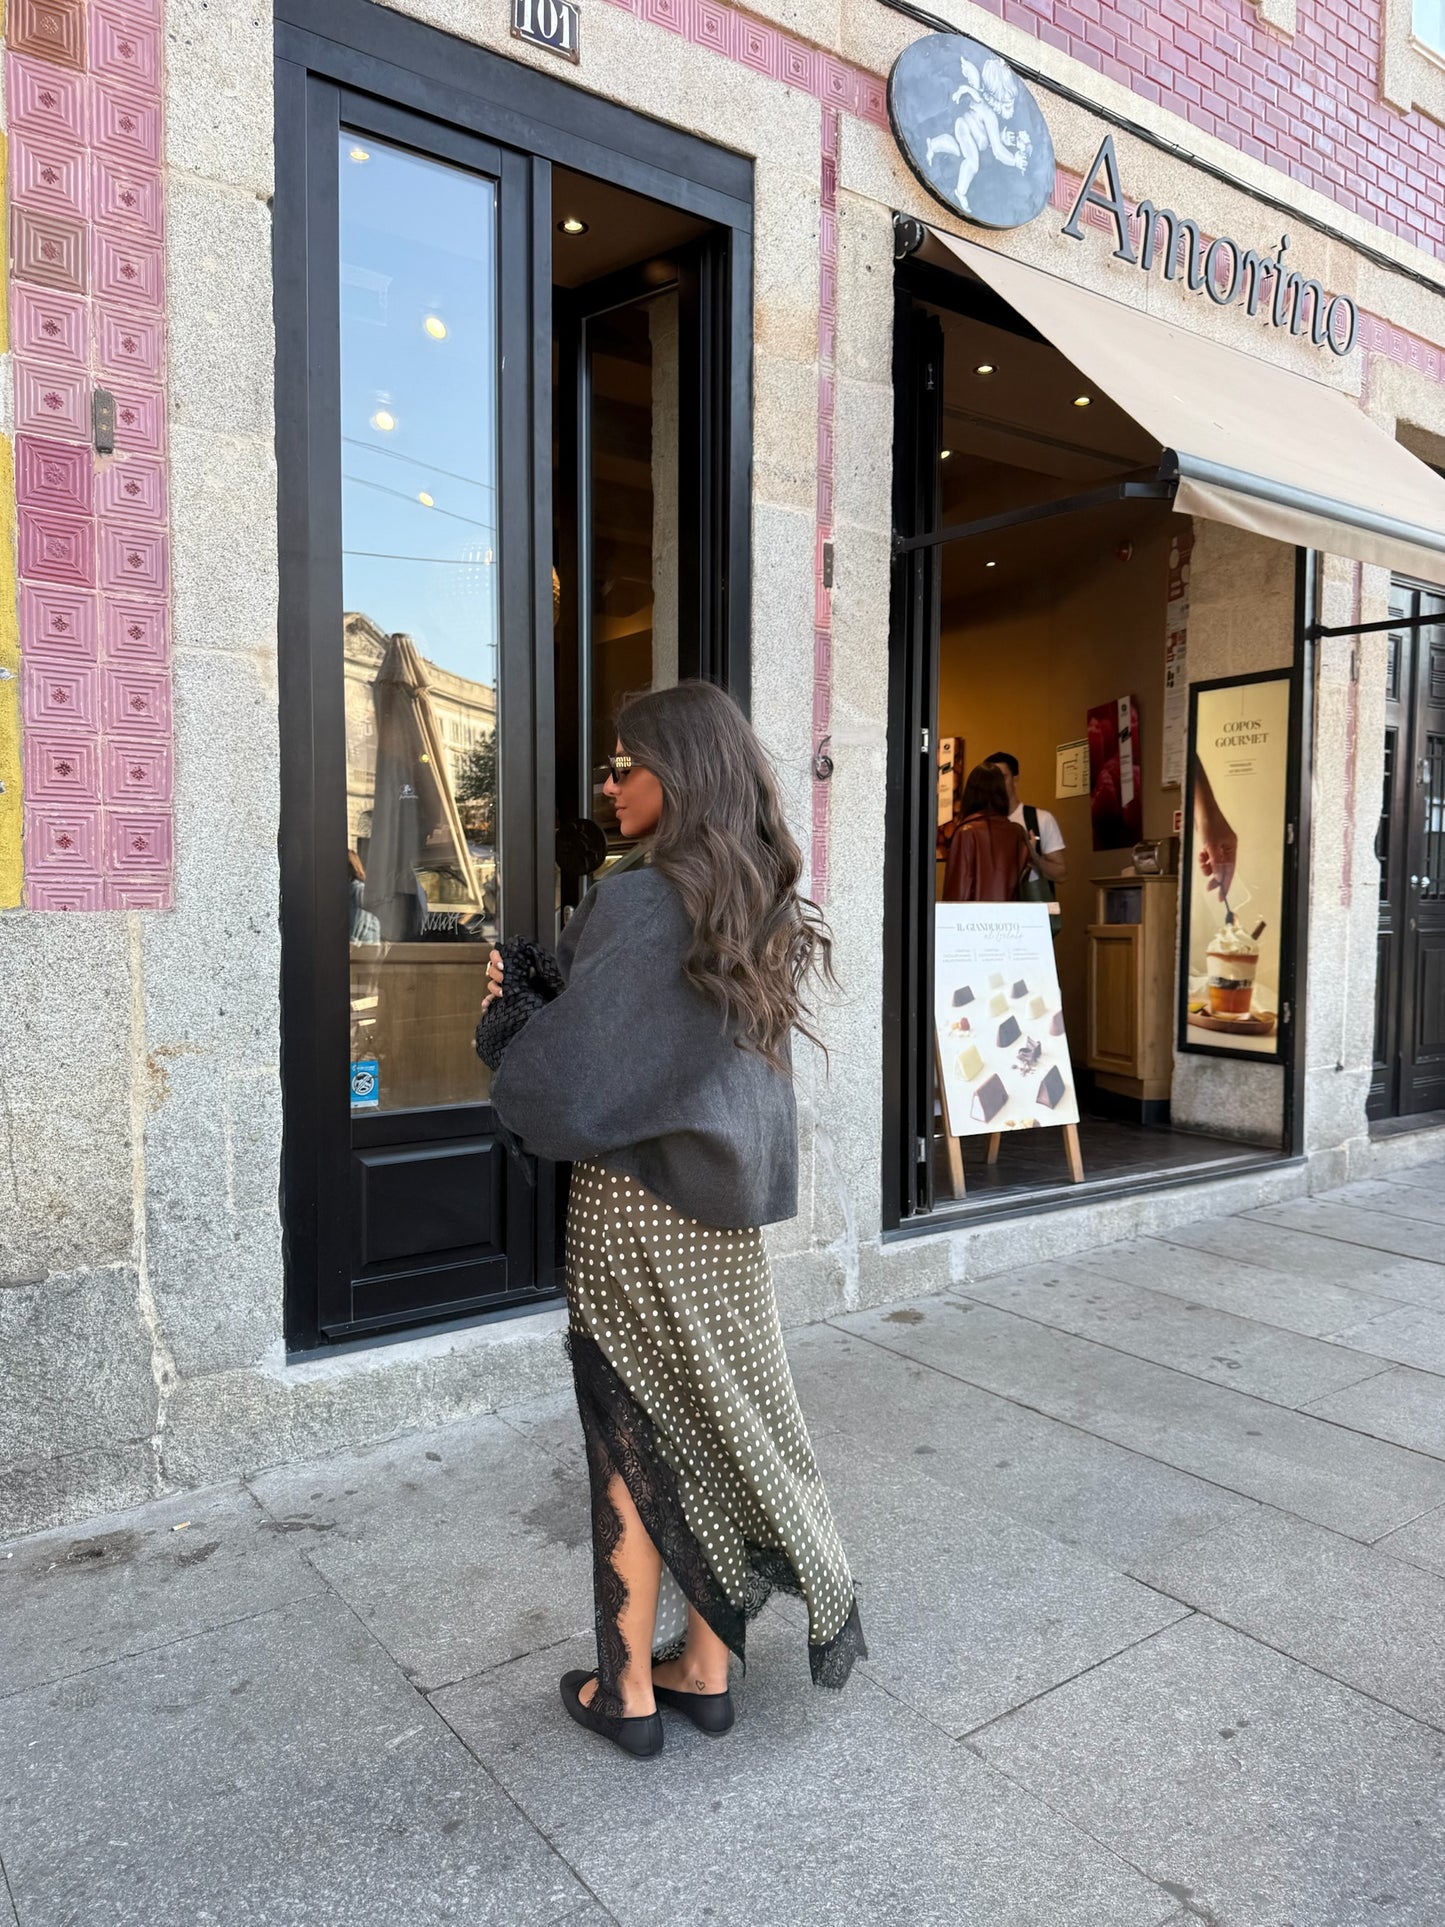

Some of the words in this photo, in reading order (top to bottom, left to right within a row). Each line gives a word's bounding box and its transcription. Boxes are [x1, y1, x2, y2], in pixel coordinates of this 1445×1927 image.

[520, 0, 570, 49] 101
[1061, 134, 1359, 357] Amorino
[1215, 732, 1269, 747] GOURMET
[1223, 719, 1261, 733] COPOS
